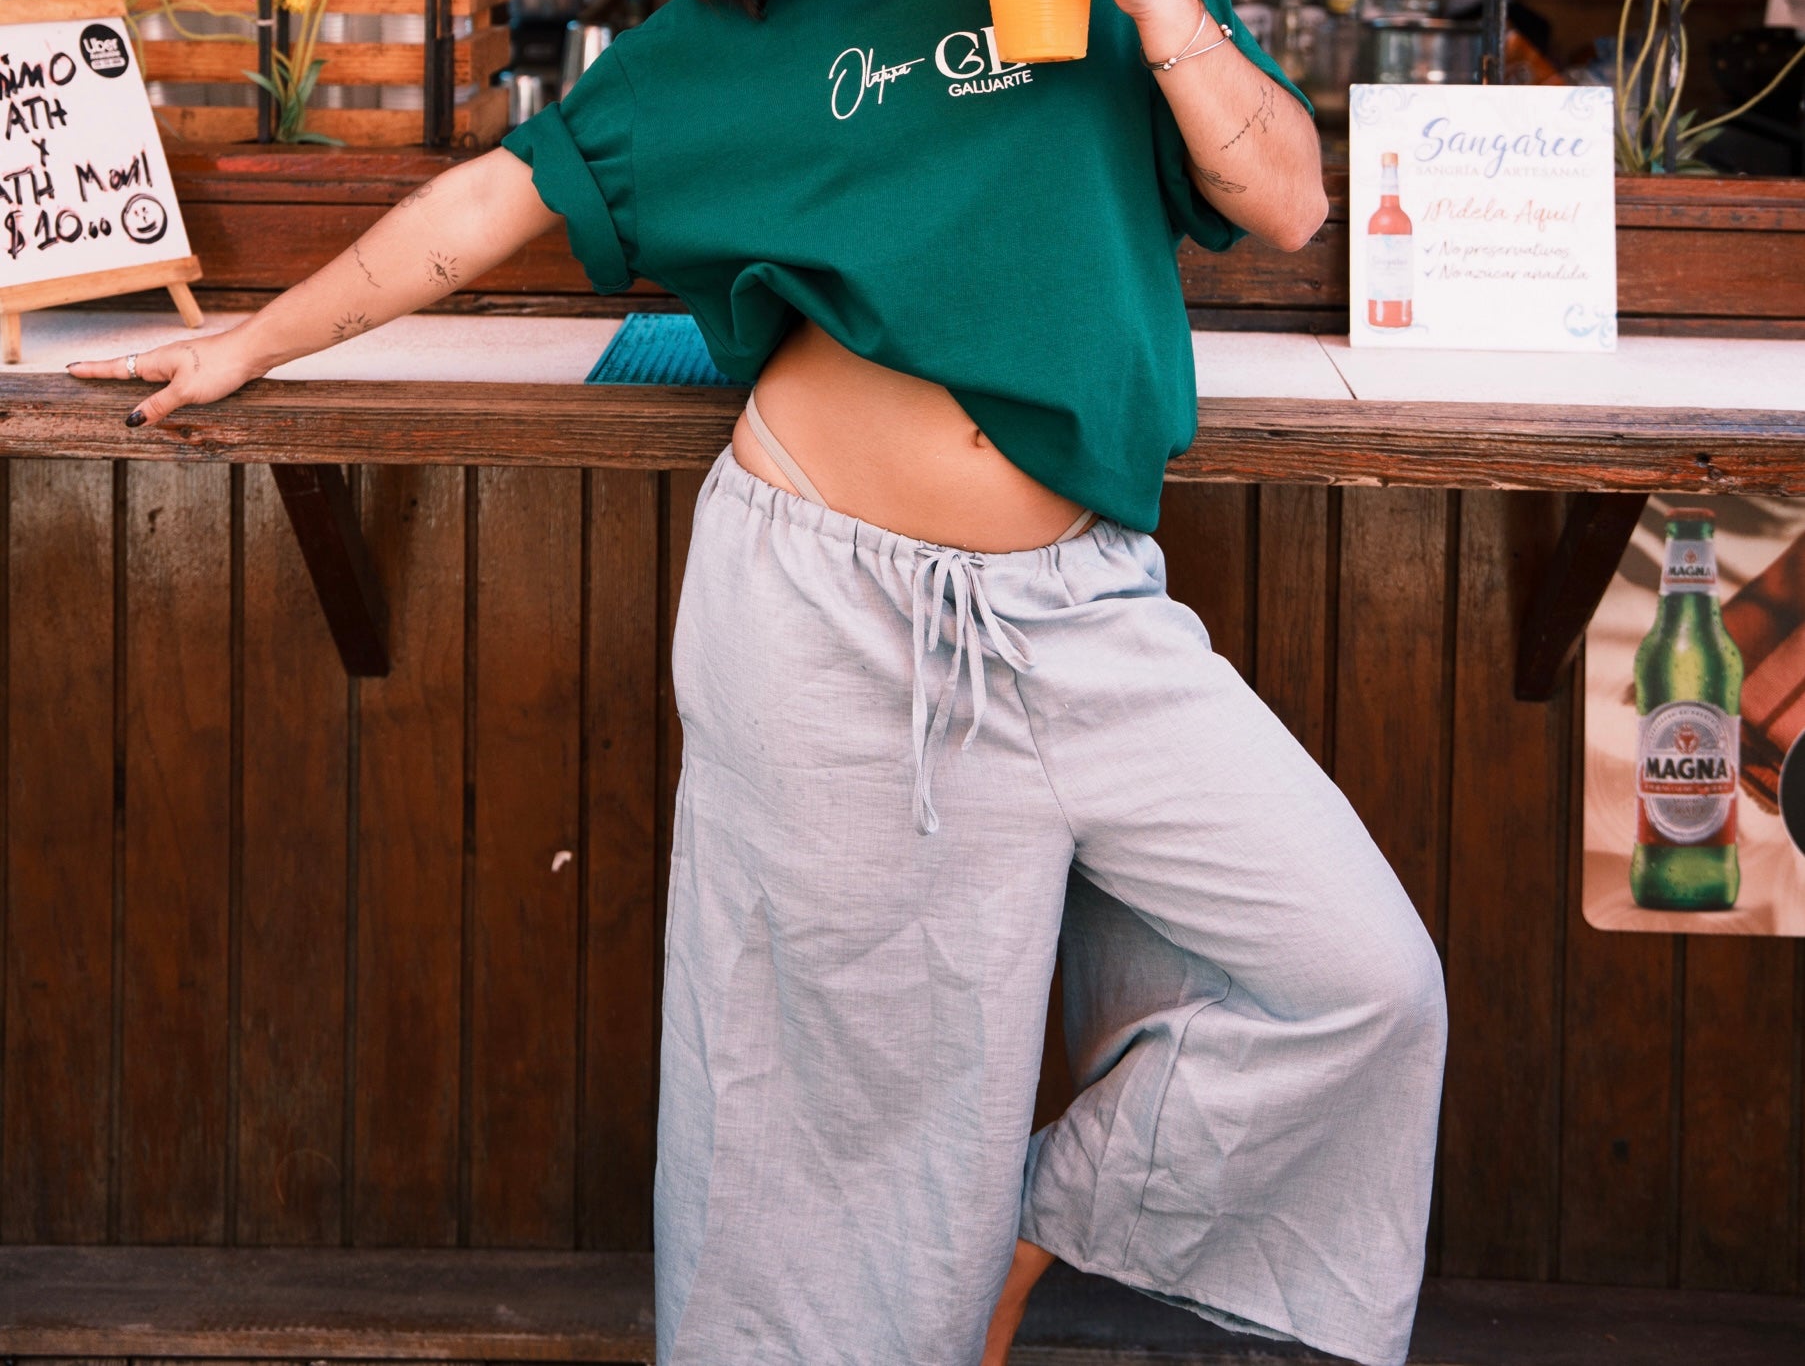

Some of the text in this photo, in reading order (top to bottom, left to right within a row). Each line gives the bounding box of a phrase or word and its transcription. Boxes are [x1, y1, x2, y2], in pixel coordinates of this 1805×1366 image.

[83, 37, 118, 54] Uber
[948, 70, 1034, 97] GALUARTE
[6, 96, 68, 140] ATH
[1414, 116, 1591, 179] Sangaree
[1438, 240, 1462, 257] No
[1438, 264, 1461, 280] No
[1668, 565, 1711, 577] MAGNA
[1645, 756, 1728, 780] MAGNA
